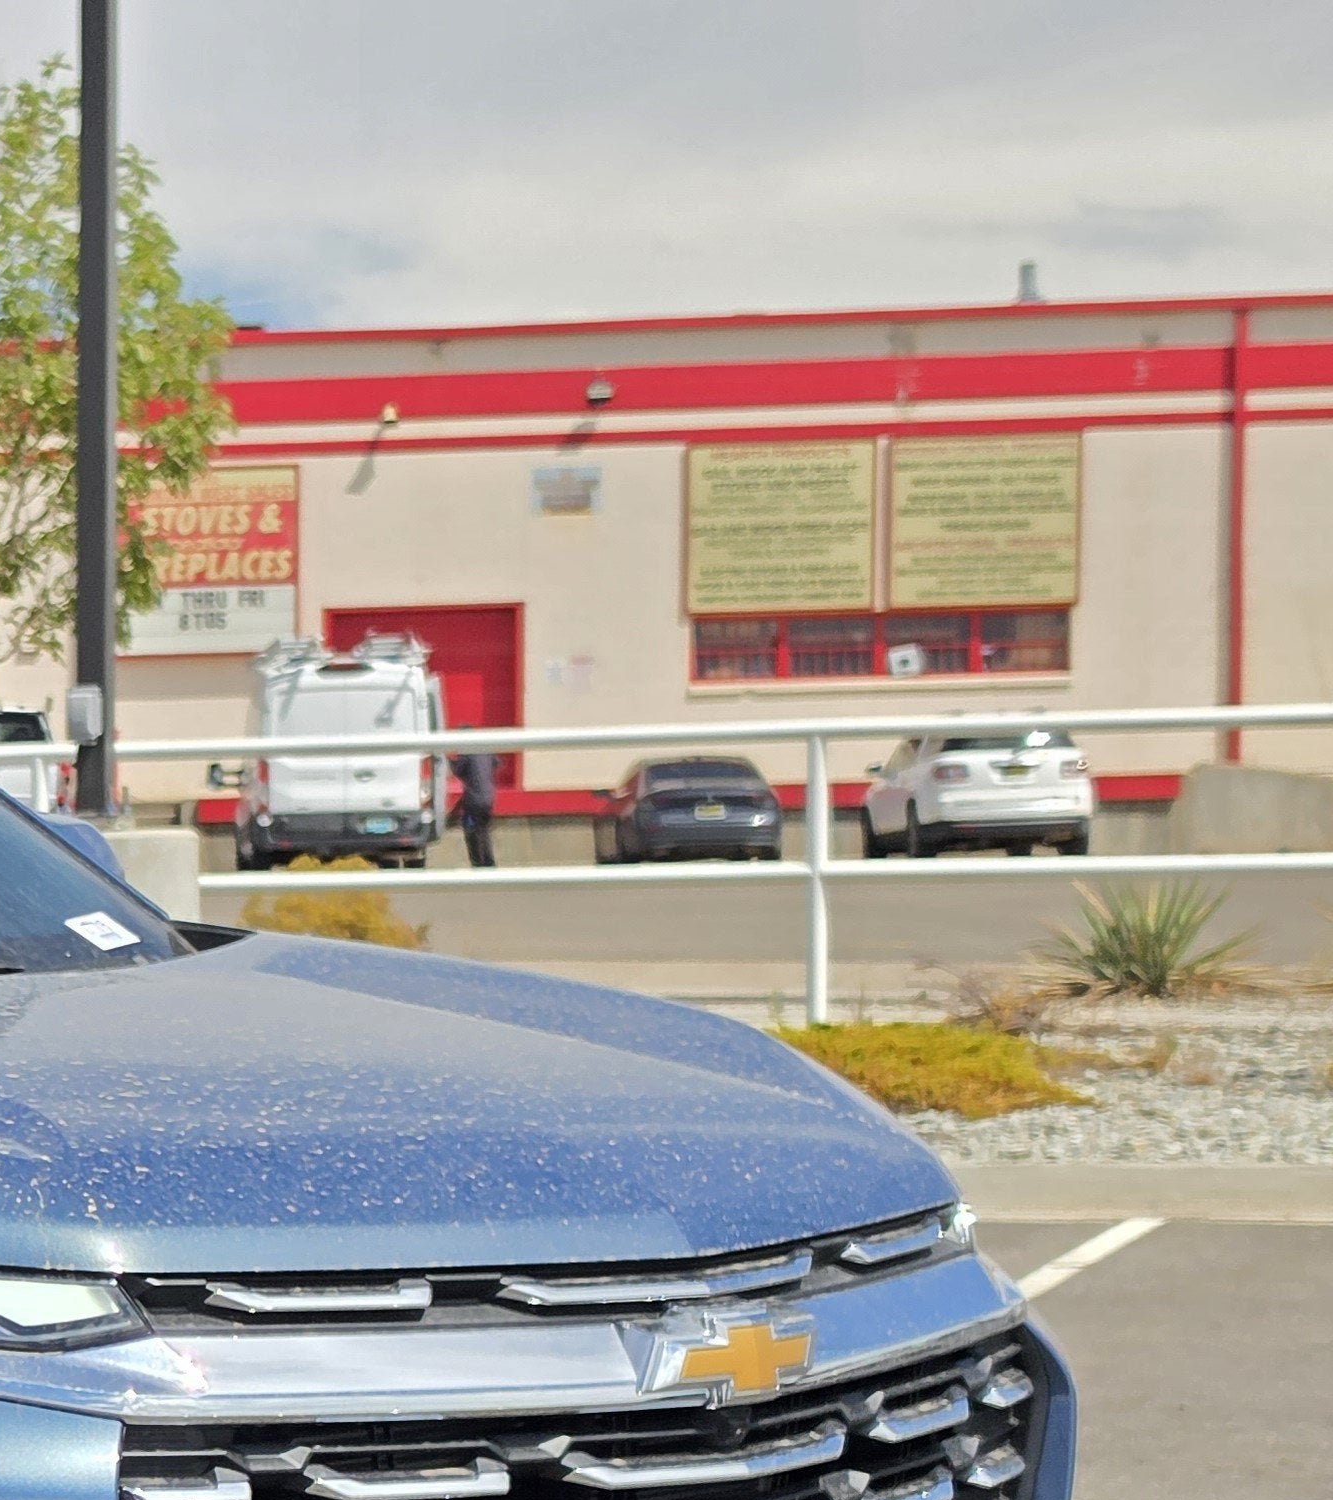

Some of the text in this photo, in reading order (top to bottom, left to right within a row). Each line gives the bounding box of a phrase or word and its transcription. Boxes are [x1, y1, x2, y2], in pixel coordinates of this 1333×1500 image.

[141, 503, 283, 537] STOVES &
[152, 551, 293, 583] REPLACES
[181, 589, 265, 609] THRU FRI
